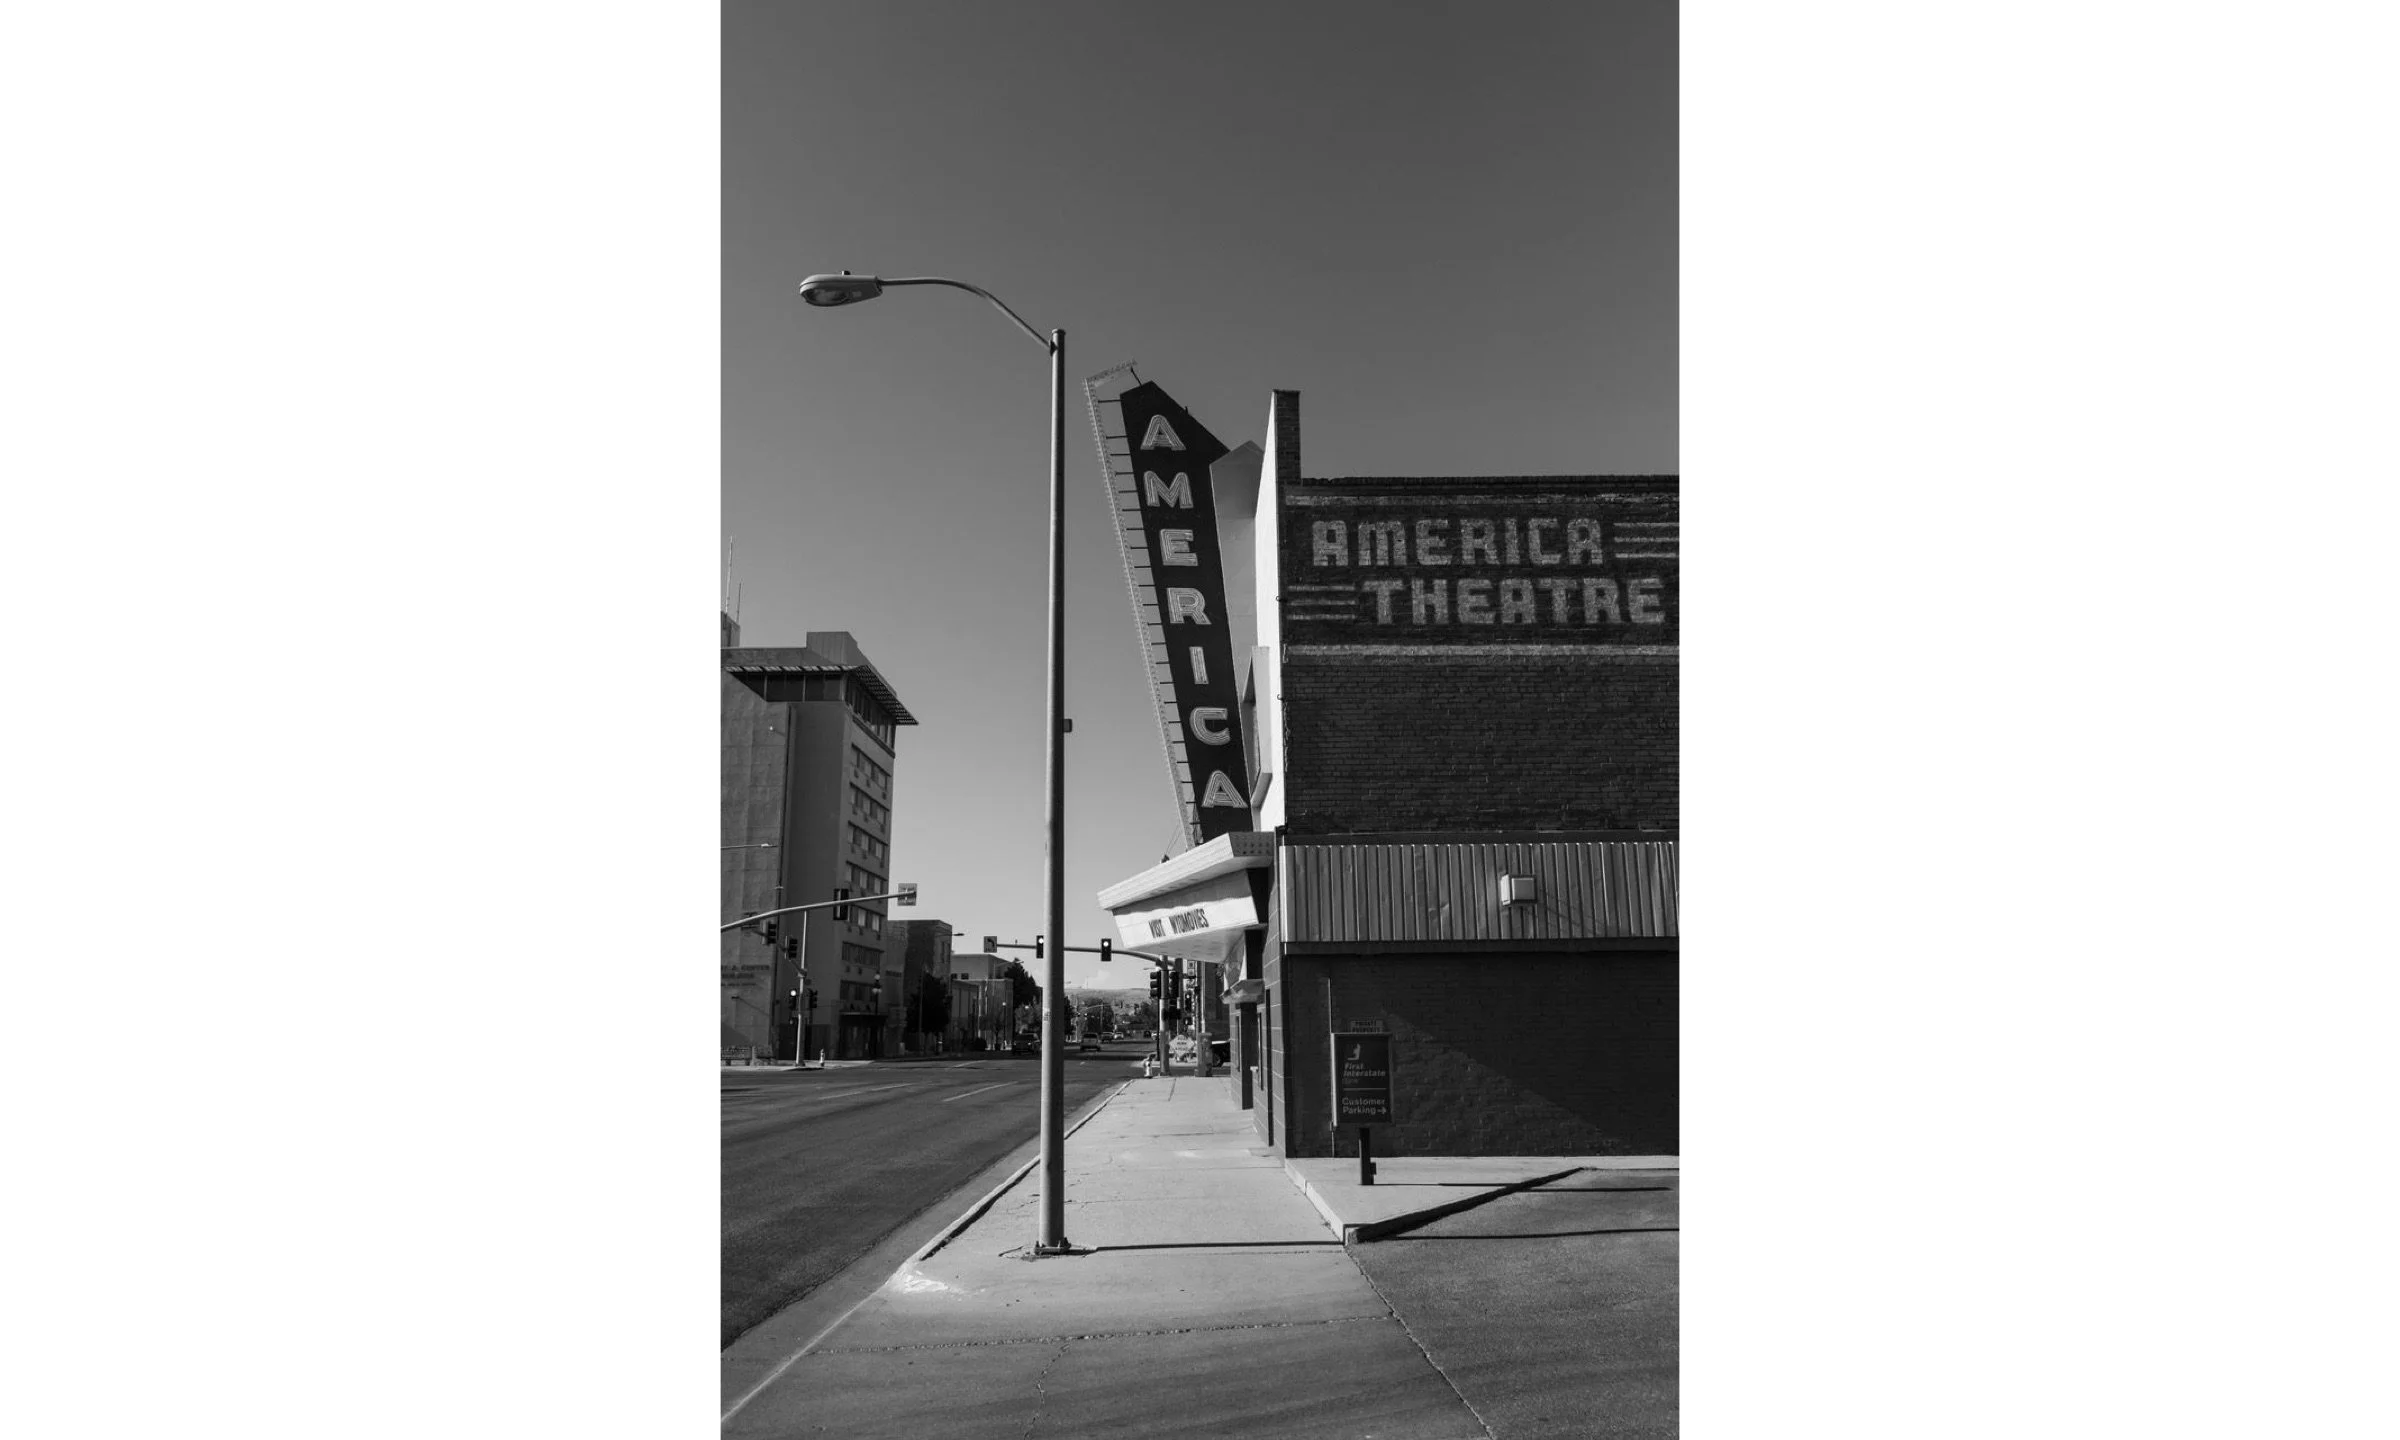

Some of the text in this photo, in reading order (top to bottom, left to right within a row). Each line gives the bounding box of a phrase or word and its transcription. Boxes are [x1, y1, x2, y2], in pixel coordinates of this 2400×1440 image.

[1312, 518, 1603, 565] AMERICA
[1361, 578, 1665, 624] THEATRE
[1140, 414, 1249, 809] AMERICA
[1344, 1062, 1364, 1070] First
[1343, 1069, 1386, 1077] Interstate
[1342, 1098, 1385, 1106] Customer
[1342, 1106, 1376, 1115] Parking
